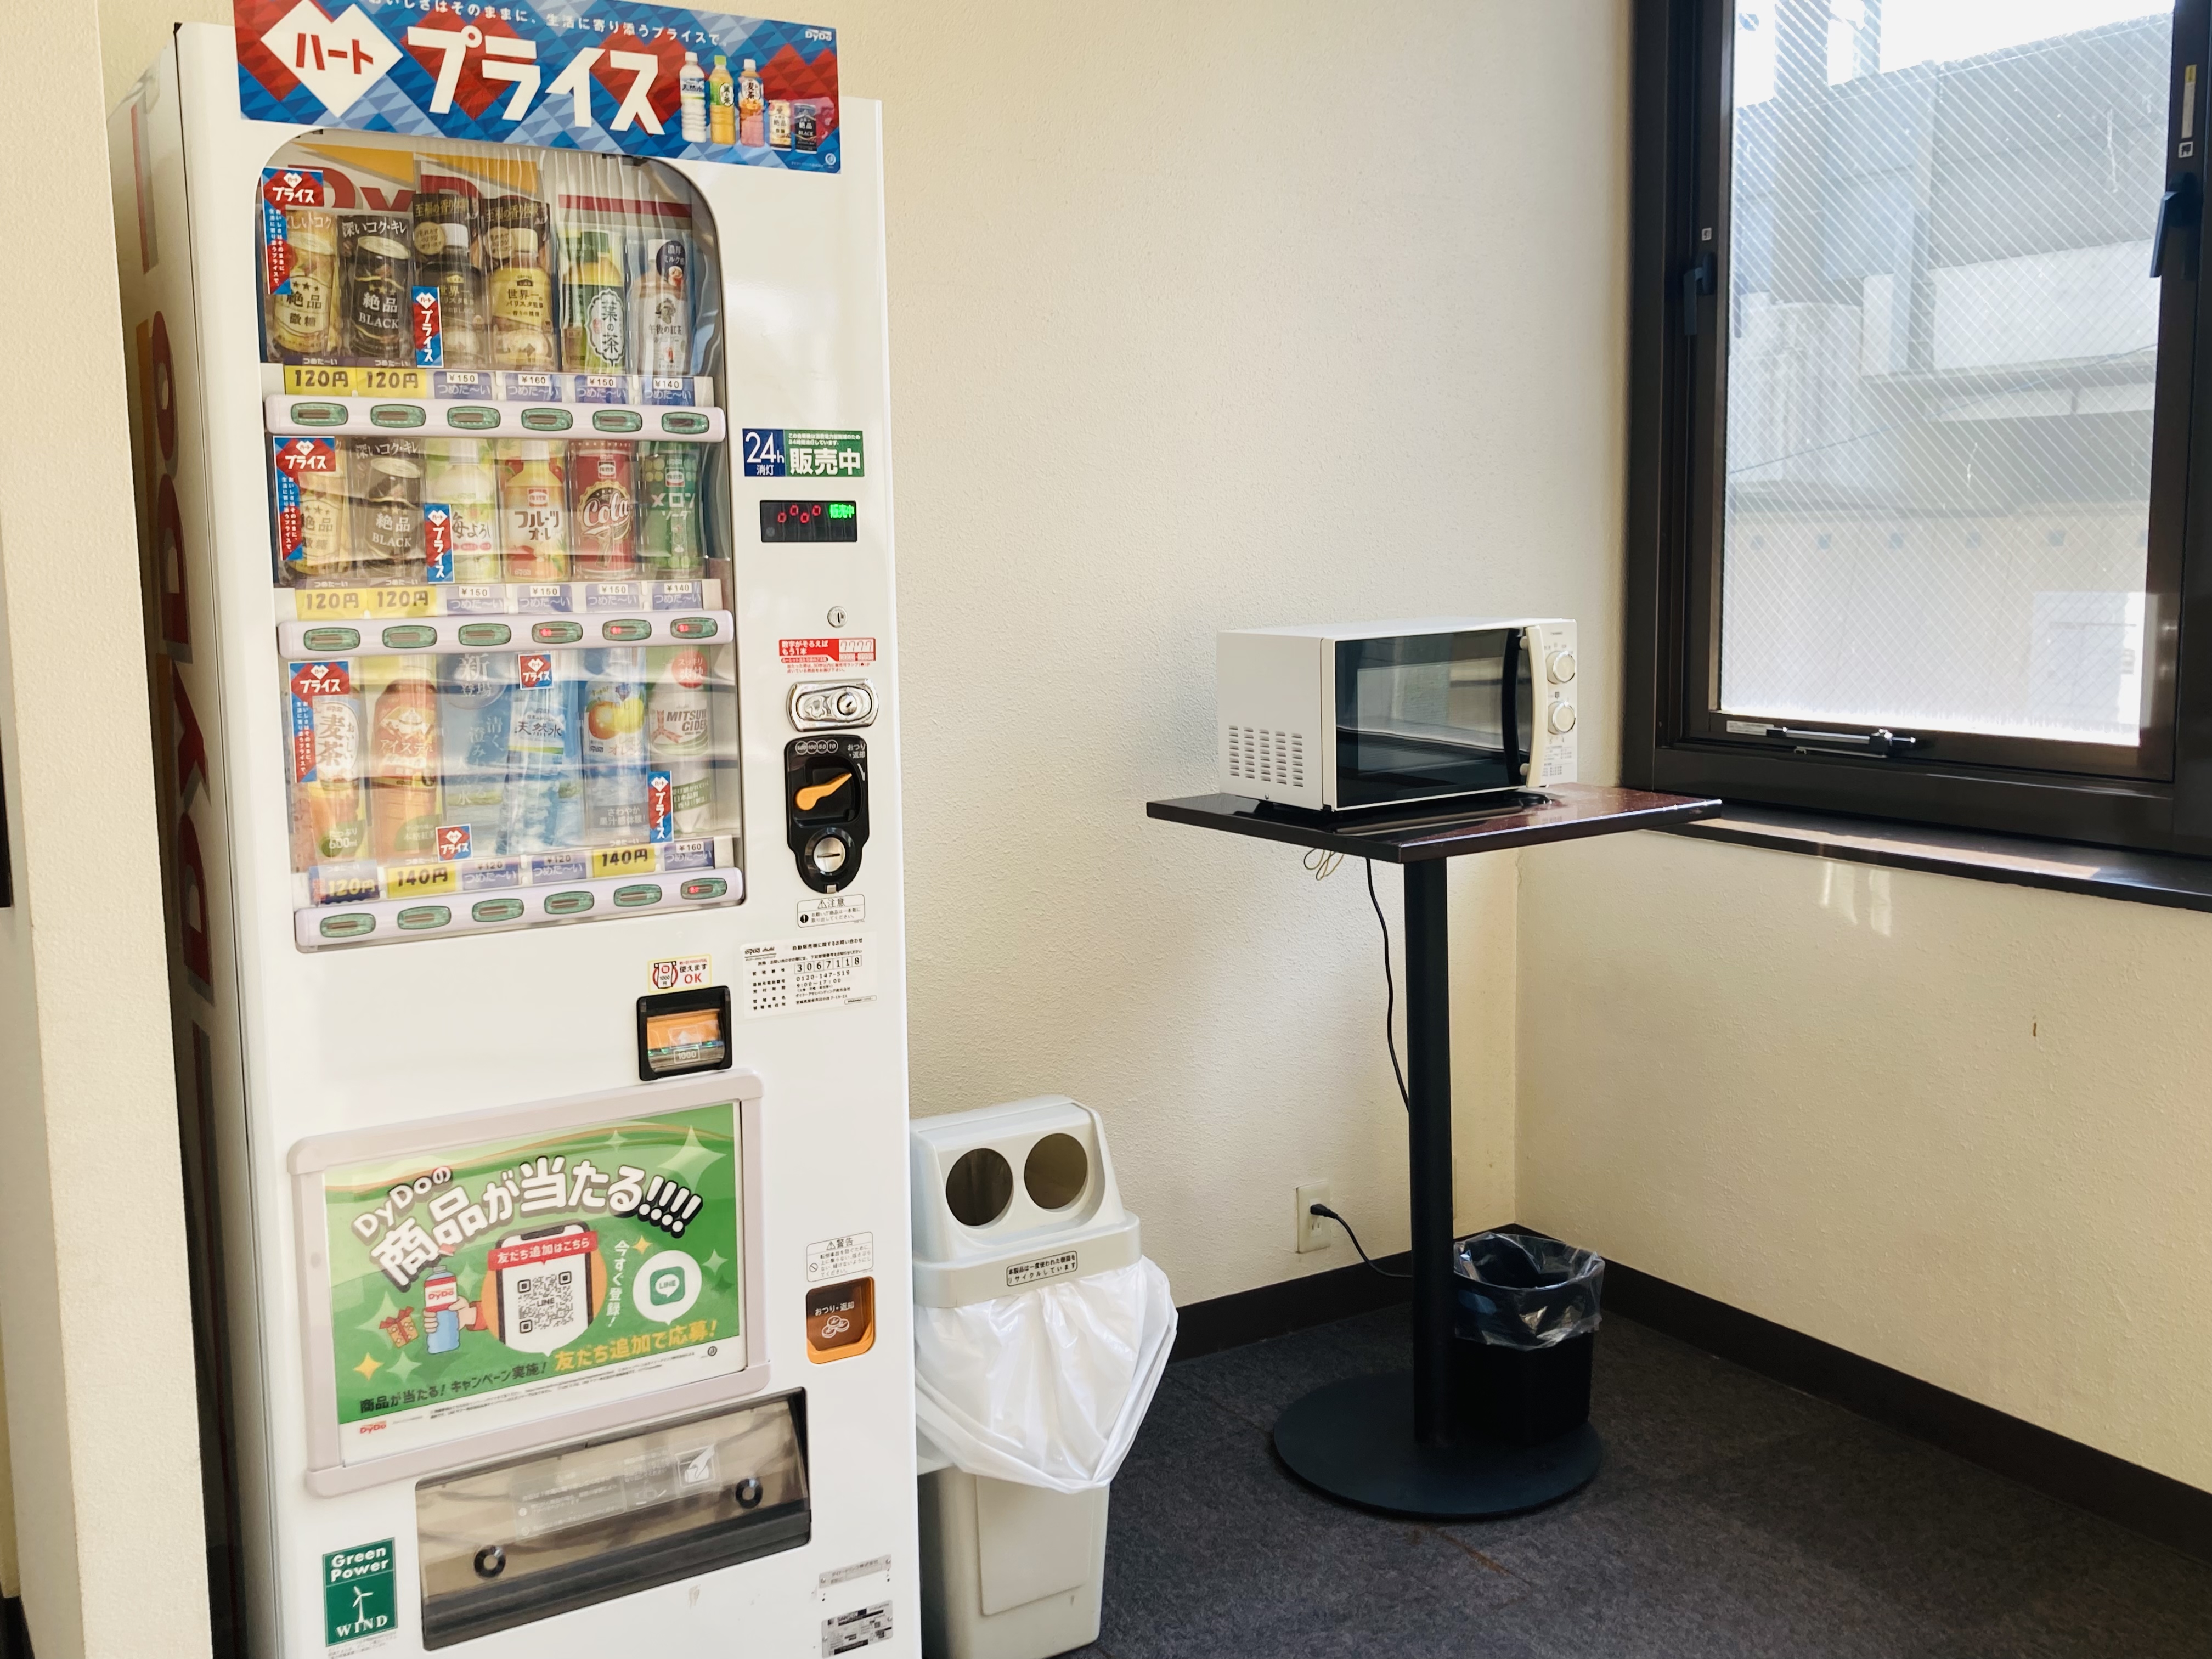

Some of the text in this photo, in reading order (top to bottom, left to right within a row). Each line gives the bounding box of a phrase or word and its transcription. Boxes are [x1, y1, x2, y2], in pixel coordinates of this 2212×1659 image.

[805, 29, 833, 42] DyDo
[296, 33, 374, 75] ハート
[407, 25, 665, 136] プライス
[272, 186, 315, 204] プライス
[287, 291, 322, 309] 絶品
[363, 291, 398, 313] 絶品
[359, 312, 399, 329] BLACK
[421, 309, 434, 363] プライス
[295, 369, 349, 387] 120円
[366, 371, 419, 388] 120円
[654, 380, 680, 389] ¥140
[285, 454, 328, 469] プライス
[757, 464, 774, 476] 消灯
[789, 448, 861, 476] 販売中
[583, 491, 630, 527] Cola
[651, 492, 696, 509] メロン
[515, 510, 560, 528] フルーツ
[830, 504, 855, 518] 販売中
[375, 512, 411, 532] 絶品
[371, 531, 412, 548] BLACK
[433, 527, 445, 578] プライス
[306, 592, 359, 610] 120円
[377, 590, 429, 608] 120円
[461, 588, 488, 597] ¥150
[781, 640, 829, 648] 数字がそろえば
[782, 647, 808, 656] もう1本
[840, 640, 872, 652] 7777
[458, 653, 490, 681] 新
[523, 671, 550, 682] プライス
[300, 679, 341, 693] プライス
[461, 682, 492, 697] 登場
[517, 721, 562, 738] 天然水
[316, 714, 346, 766] 麦茶
[847, 743, 866, 752] おつり
[656, 792, 667, 840] プライス
[441, 842, 470, 855] プライス
[679, 843, 702, 852] ¥160
[602, 848, 648, 867] 140円
[397, 867, 448, 887] 140円
[328, 877, 375, 897] 120円
[827, 897, 845, 908] 注意
[680, 963, 708, 973] 使えます
[797, 957, 860, 973] 3067118
[684, 973, 702, 984] OK
[796, 970, 850, 982] 0120-147-519
[678, 1050, 697, 1060] 1000
[353, 1166, 452, 1238] DyDoの
[371, 1154, 703, 1292] 商品が当たる!!!!
[497, 1238, 590, 1264] 友だち追加はこちら
[837, 1237, 854, 1249] 警告
[1008, 1262, 1076, 1284] リサイクルしています
[607, 1239, 630, 1328] 今すぐ登録!
[658, 1279, 677, 1289] LINE
[428, 1288, 455, 1300] DyDo
[537, 1297, 555, 1307] LINE
[815, 1301, 855, 1316] おつり・返却
[555, 1318, 718, 1372] 友だち追加で応募!
[360, 1421, 387, 1434] DyDo
[331, 1547, 387, 1568] Green
[330, 1559, 390, 1583] Power
[335, 1615, 388, 1638] WIND
